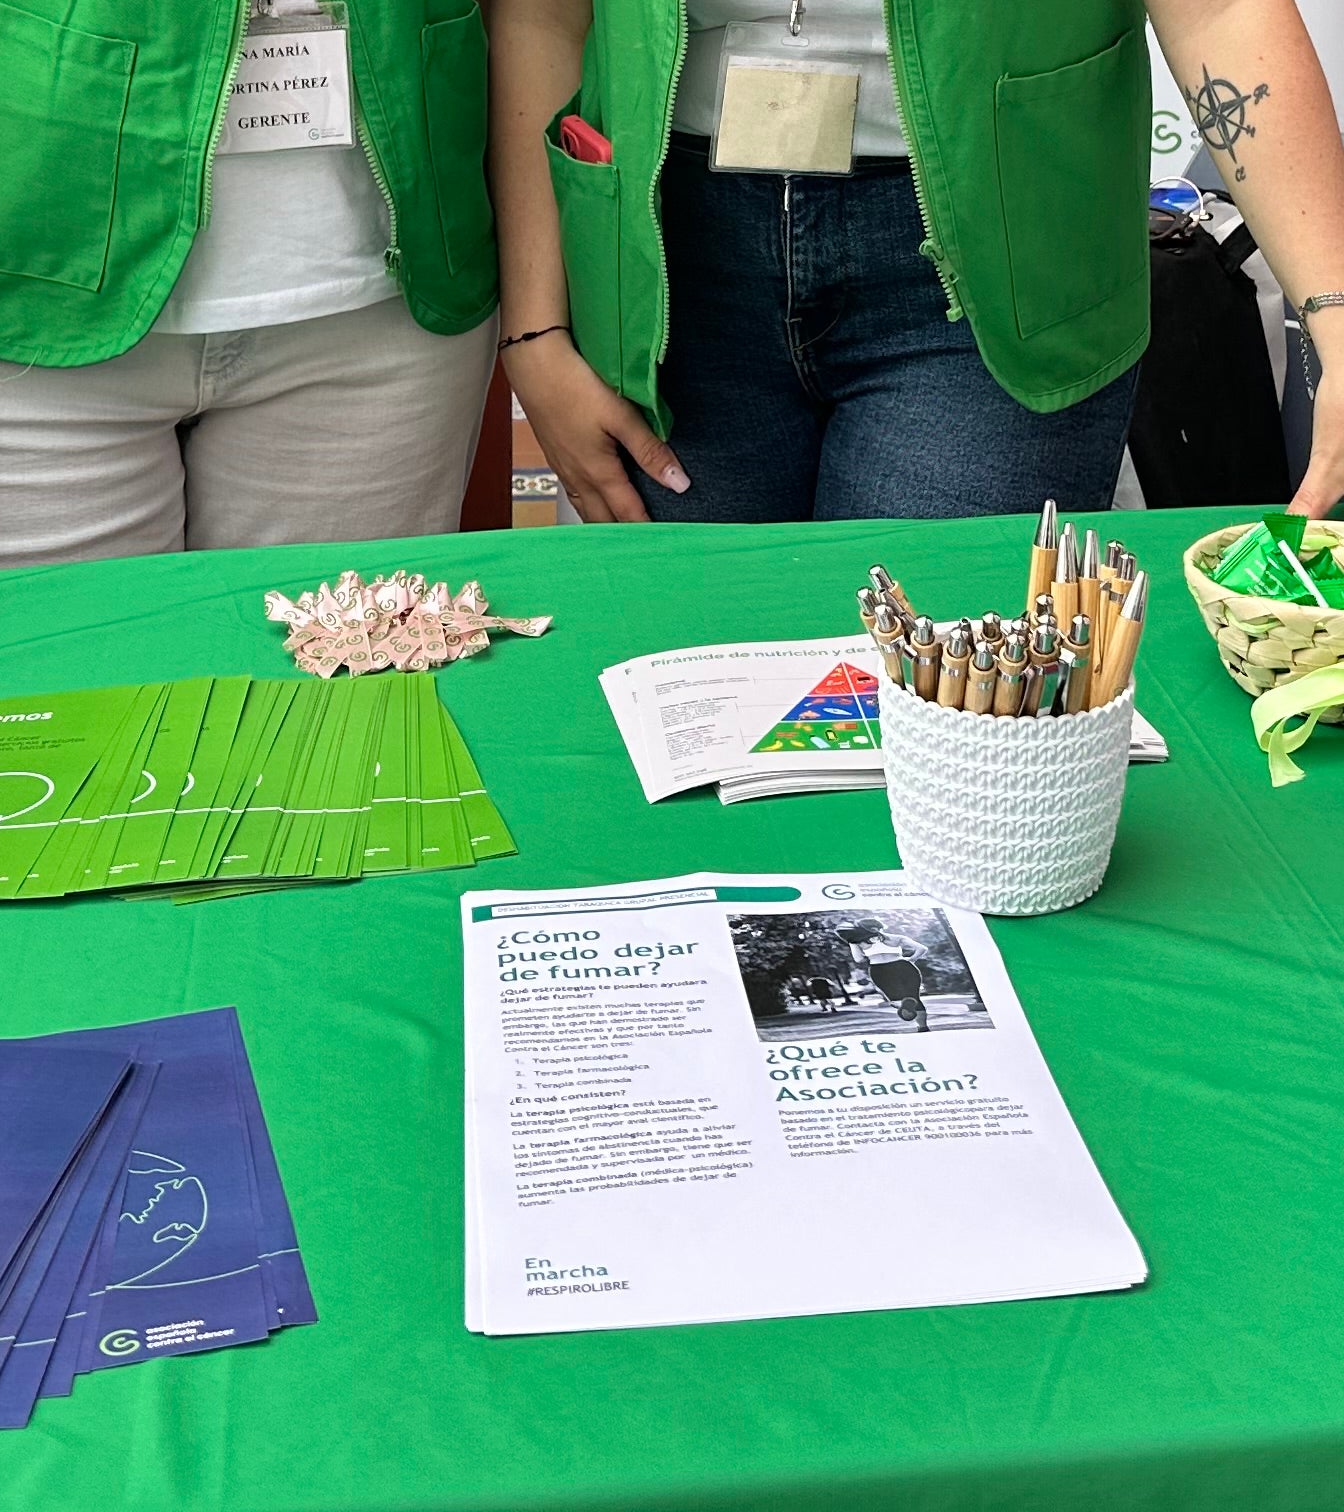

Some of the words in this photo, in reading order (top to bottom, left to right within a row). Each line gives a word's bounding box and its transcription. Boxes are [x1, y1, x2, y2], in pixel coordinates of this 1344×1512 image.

[263, 42, 310, 59] MARÍA
[284, 76, 328, 90] PÉREZ
[238, 112, 310, 129] GERENTE
[651, 653, 724, 667] Pirámide
[754, 648, 828, 657] nutrición
[497, 930, 600, 949] ¿Cómo
[498, 946, 598, 967] puedo
[615, 941, 699, 959] dejar
[500, 967, 539, 982] de
[548, 962, 661, 979] fumar?
[766, 1041, 848, 1064] ¿Qué
[861, 1040, 896, 1054] te
[769, 1061, 882, 1081] ofrece
[895, 1058, 926, 1074] la
[776, 1074, 978, 1102] Asociación?
[525, 1258, 551, 1269] En
[527, 1266, 608, 1281] marcha
[527, 1281, 630, 1296] #RESPIROLIBRE
[146, 1320, 204, 1334] asociación
[146, 1328, 196, 1341] española
[146, 1337, 183, 1348] contra
[197, 1329, 234, 1339] cáncer
